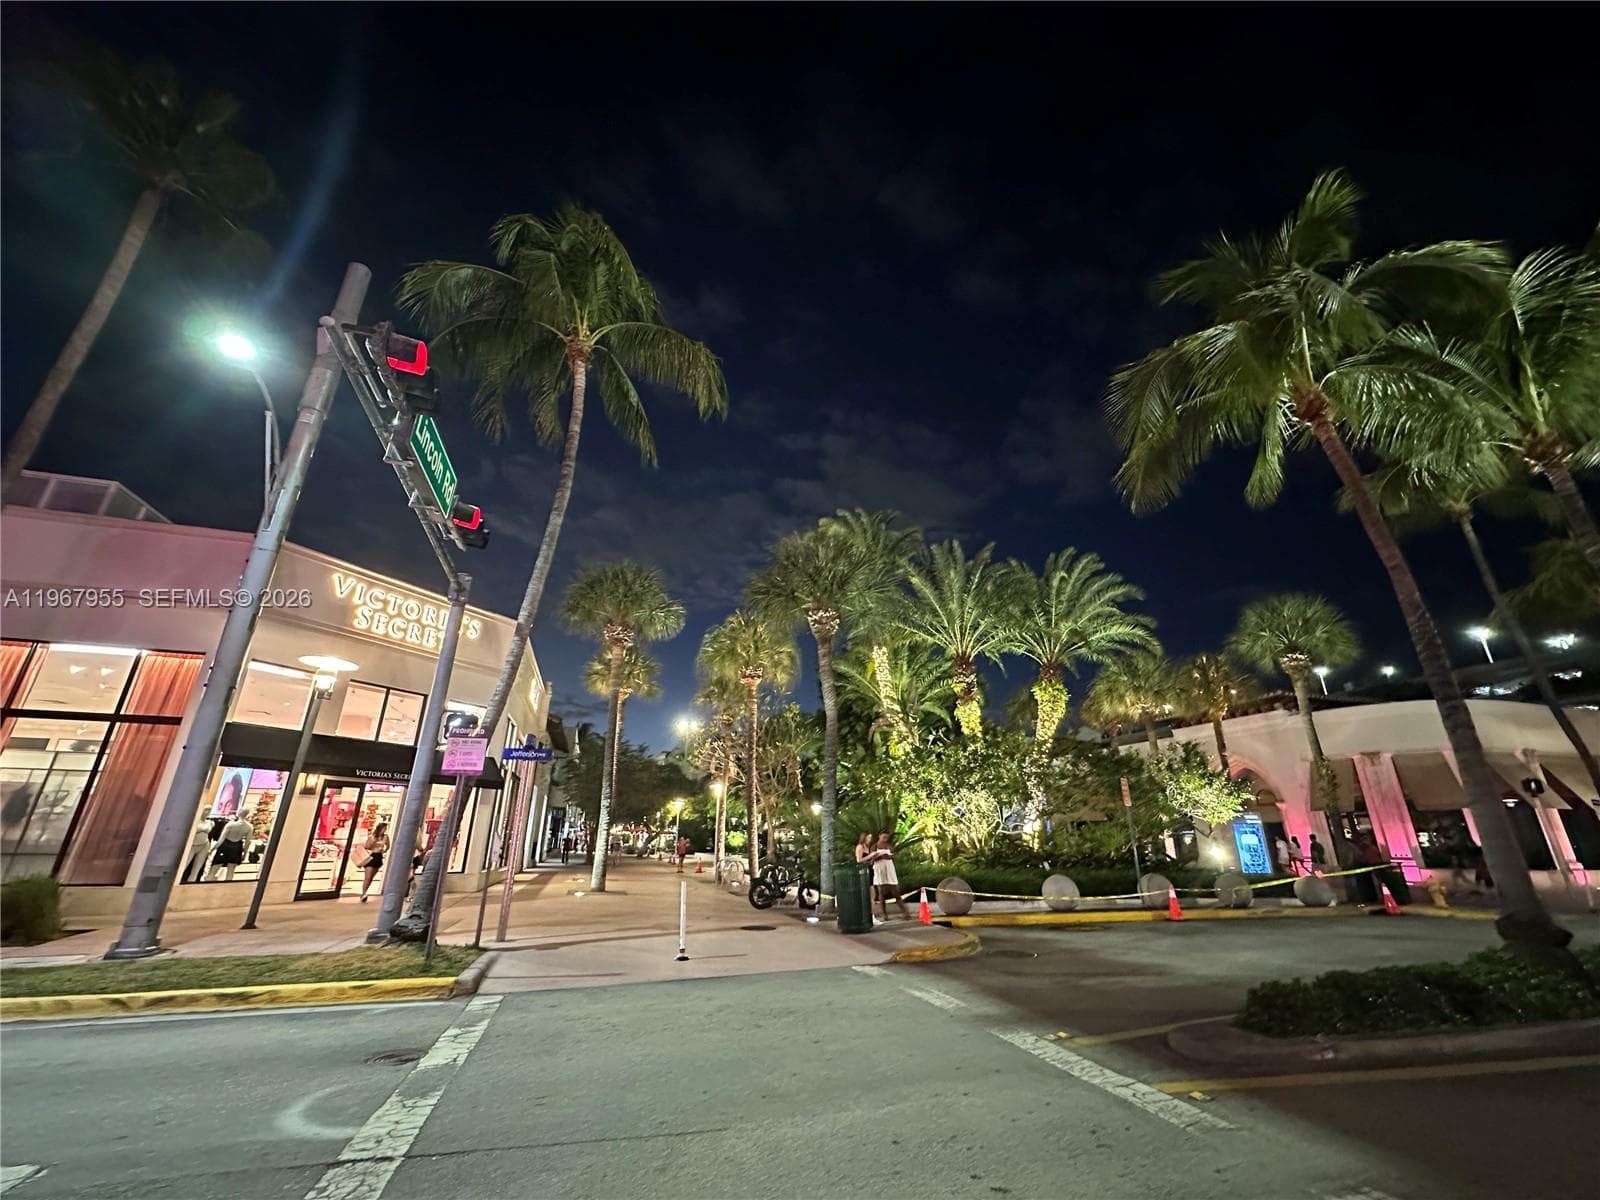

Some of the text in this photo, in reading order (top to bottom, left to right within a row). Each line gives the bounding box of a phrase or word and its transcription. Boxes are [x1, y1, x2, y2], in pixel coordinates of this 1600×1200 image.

[416, 415, 454, 505] Lincoln Rd
[332, 573, 481, 639] VICTORI'S
[356, 768, 411, 780] VICTORIA'S SECR
